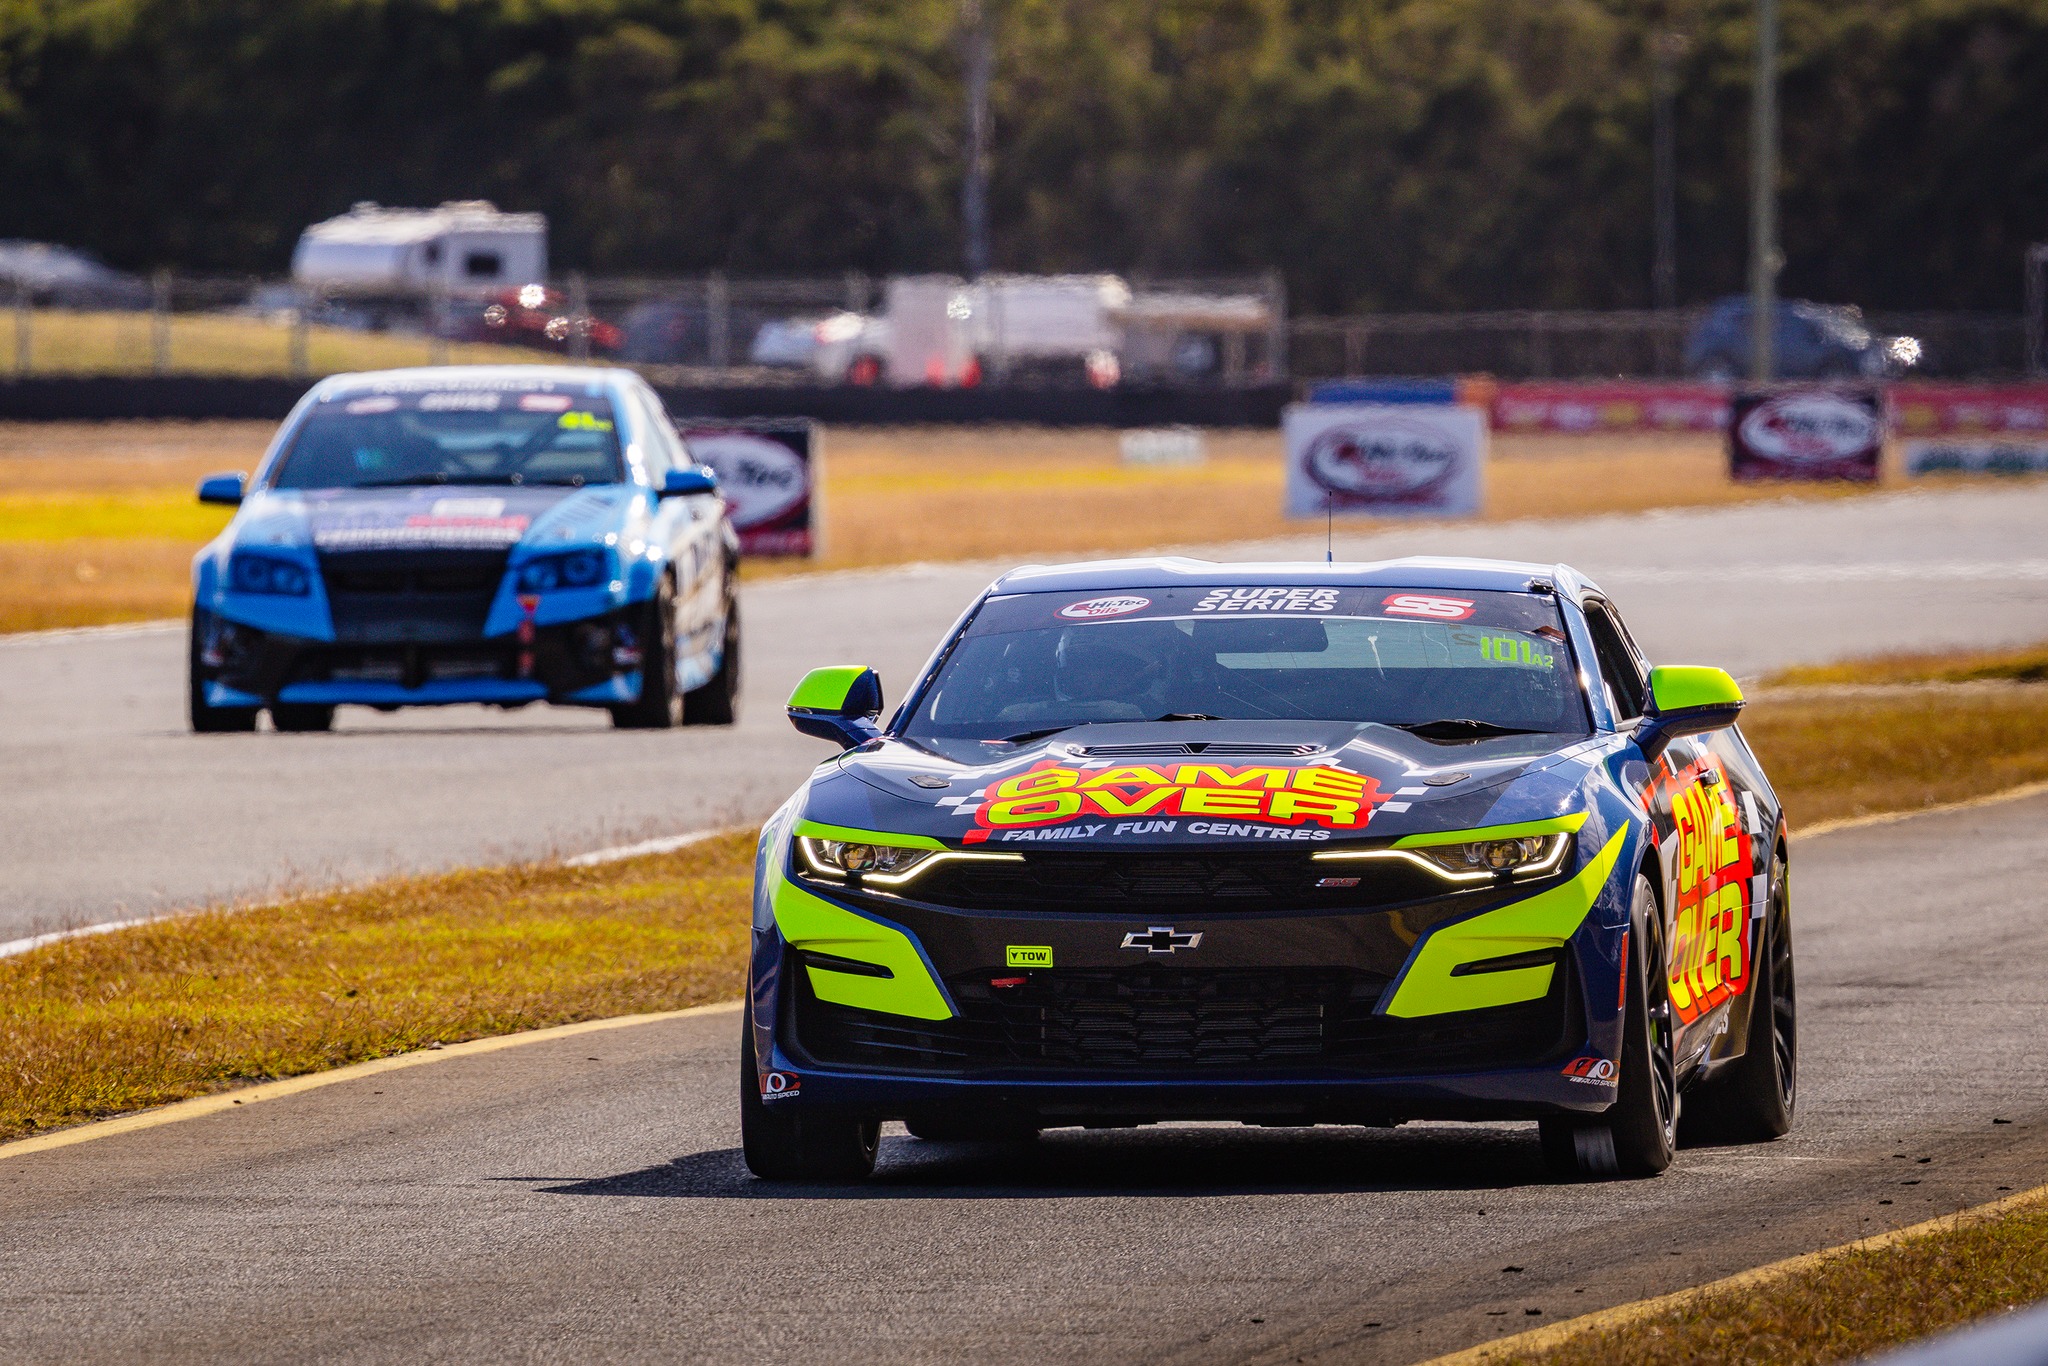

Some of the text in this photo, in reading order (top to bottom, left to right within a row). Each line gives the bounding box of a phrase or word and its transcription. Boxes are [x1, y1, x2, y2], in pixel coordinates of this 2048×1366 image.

[1091, 599, 1148, 609] Hi-Tec
[1205, 588, 1340, 600] SUPER
[1088, 607, 1120, 615] Oils
[1193, 599, 1338, 612] SERIES
[1387, 595, 1475, 617] SS
[1480, 636, 1531, 664] 101
[996, 765, 1369, 799] GAME
[987, 787, 1364, 825] OVER
[1001, 820, 1332, 842] FAMILY FUN CENTRES
[1671, 768, 1740, 895] GAME
[1020, 951, 1047, 961] TOW
[1668, 882, 1743, 1010] OVER
